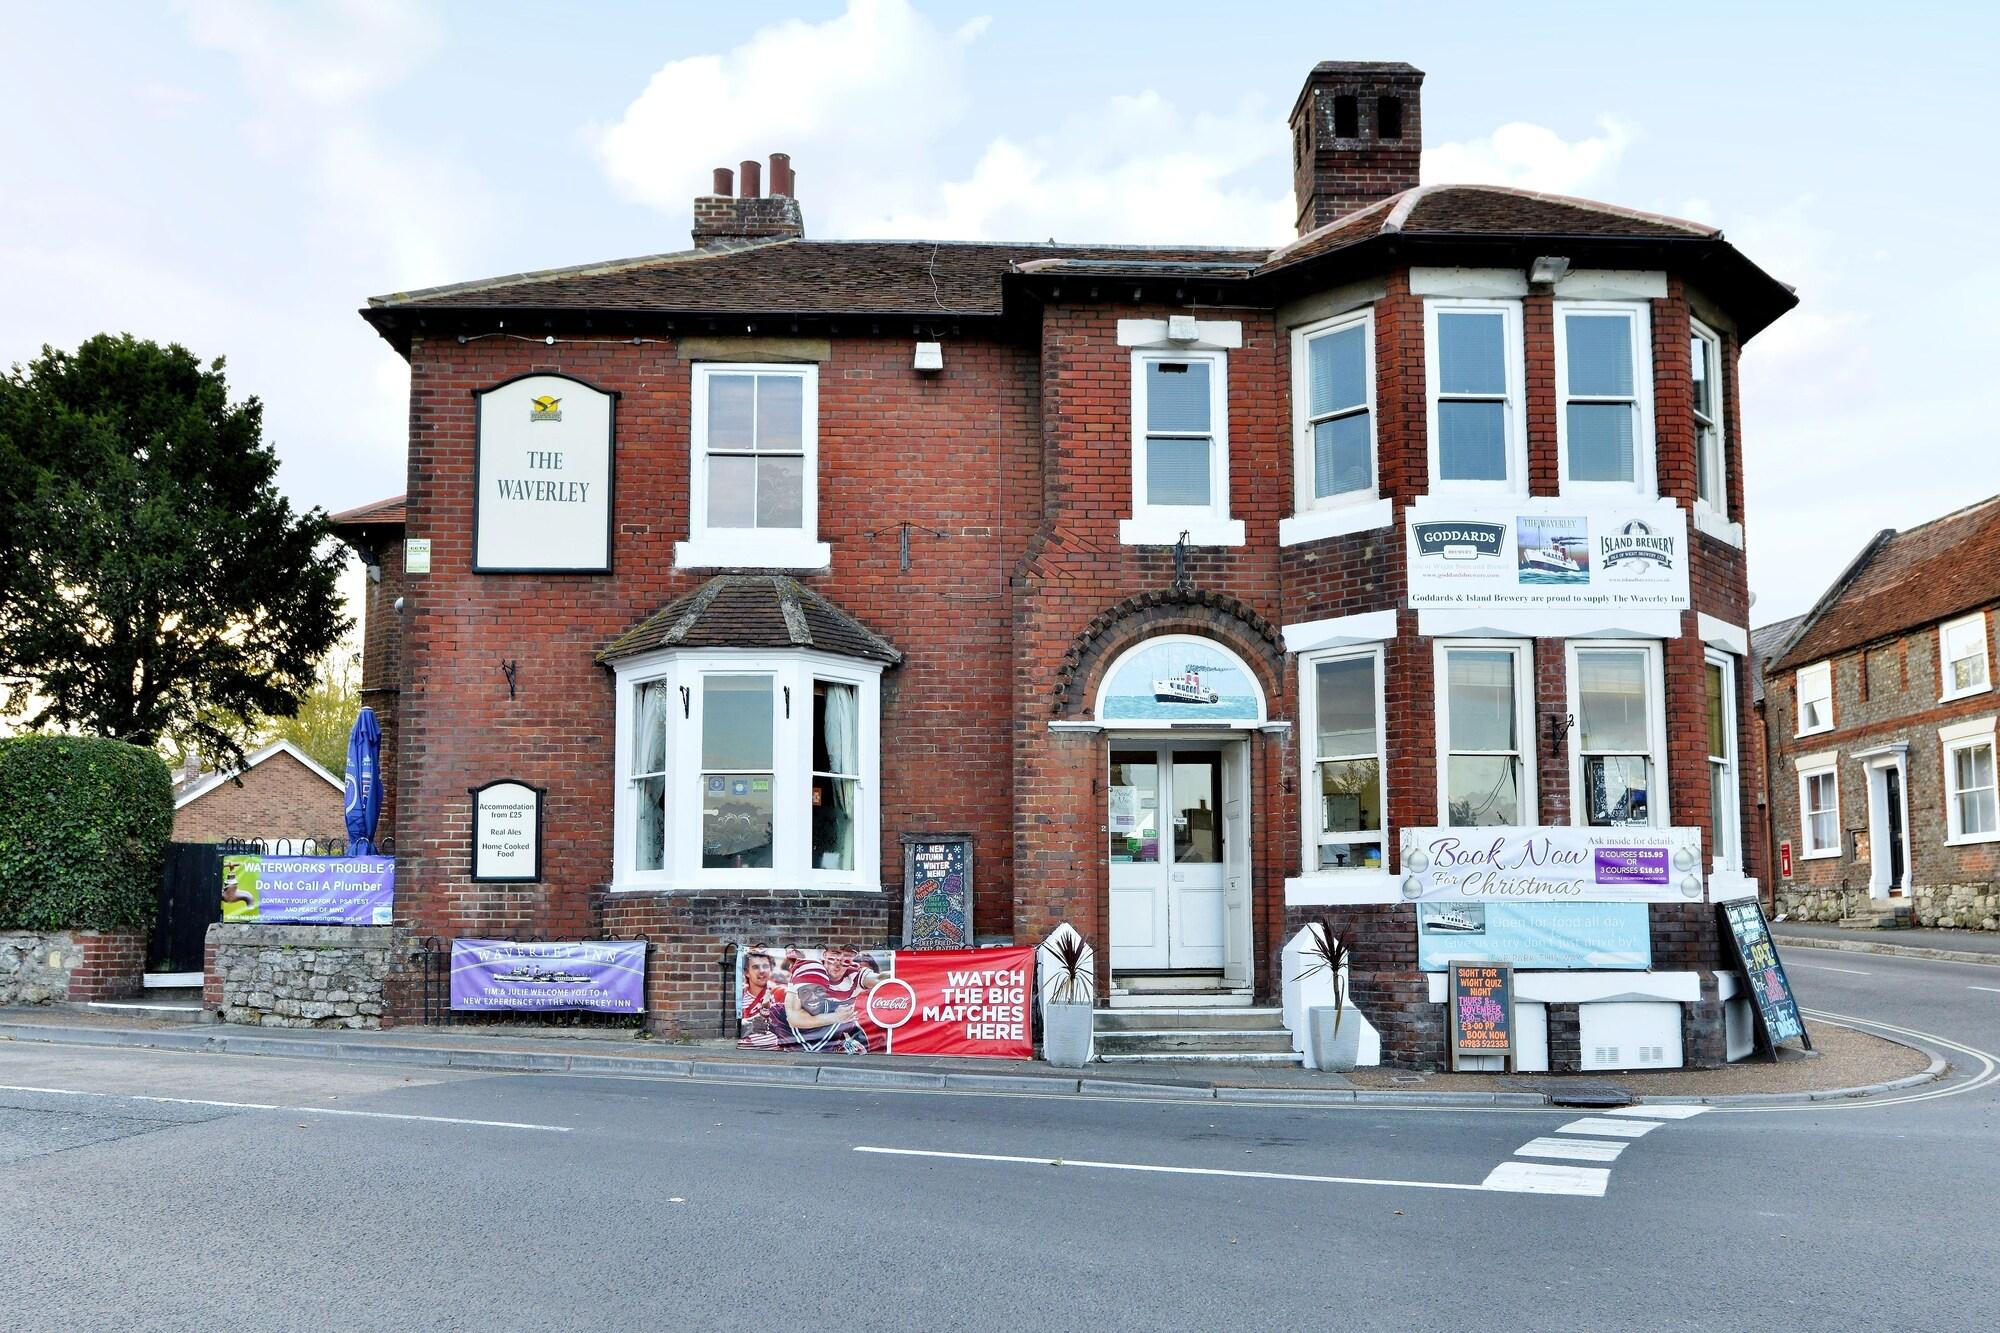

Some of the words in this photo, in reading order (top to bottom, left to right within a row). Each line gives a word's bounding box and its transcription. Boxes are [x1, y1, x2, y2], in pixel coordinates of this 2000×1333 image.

[527, 451, 563, 470] THE
[498, 480, 590, 502] WAVERLEY
[1524, 519, 1538, 528] THE
[1424, 530, 1496, 542] GODDARDS
[1600, 536, 1632, 556] ISLAND
[1636, 536, 1674, 556] BREWERY
[1412, 594, 1454, 602] Goddards
[1456, 594, 1464, 602] &
[1466, 594, 1492, 602] Island
[1494, 594, 1528, 604] Brewery
[1546, 594, 1570, 604] proud
[1584, 595, 1610, 604] supply
[1630, 595, 1668, 604] Waverley
[1588, 836, 1604, 845] Ask
[1606, 836, 1630, 845] inside
[1633, 836, 1646, 845] for
[1647, 836, 1674, 845] details
[930, 844, 944, 853] NEW
[1429, 837, 1506, 870] Book
[1511, 838, 1588, 870] Now
[244, 862, 326, 874] WATERWORKS
[329, 863, 384, 874] TROUBLE
[388, 863, 395, 874] ?
[924, 862, 950, 870] WINTER
[256, 880, 270, 890] Do
[274, 880, 294, 890] Not
[296, 880, 318, 891] Call
[322, 881, 330, 890] A
[334, 881, 382, 891] Plumber
[1432, 872, 1458, 886] For
[1461, 872, 1584, 896] Christmas
[1530, 916, 1546, 928] for
[1552, 916, 1582, 928] food
[1584, 916, 1600, 928] all
[479, 946, 573, 961] WAVERLEY
[584, 947, 618, 963] INN
[947, 971, 1025, 986] WATCH
[1458, 968, 1479, 978] SIGHT
[1482, 968, 1497, 978] FOR
[1460, 978, 1482, 987] WIGHT
[1485, 979, 1502, 988] QUIZ
[942, 988, 984, 1004] THE
[989, 988, 1025, 1004] BIG
[1470, 988, 1492, 996] NIGHT
[872, 996, 911, 1009] Coca-Cola
[1459, 997, 1482, 1006] THURS
[922, 1006, 1024, 1022] MATCHES
[1462, 1006, 1501, 1015] NOVEMBER
[1486, 1022, 1495, 1030] PP
[966, 1024, 1024, 1040] HERE
[1466, 1031, 1488, 1039] BOOK
[1489, 1031, 1506, 1039] NOW
[1460, 1040, 1480, 1048] 01983
